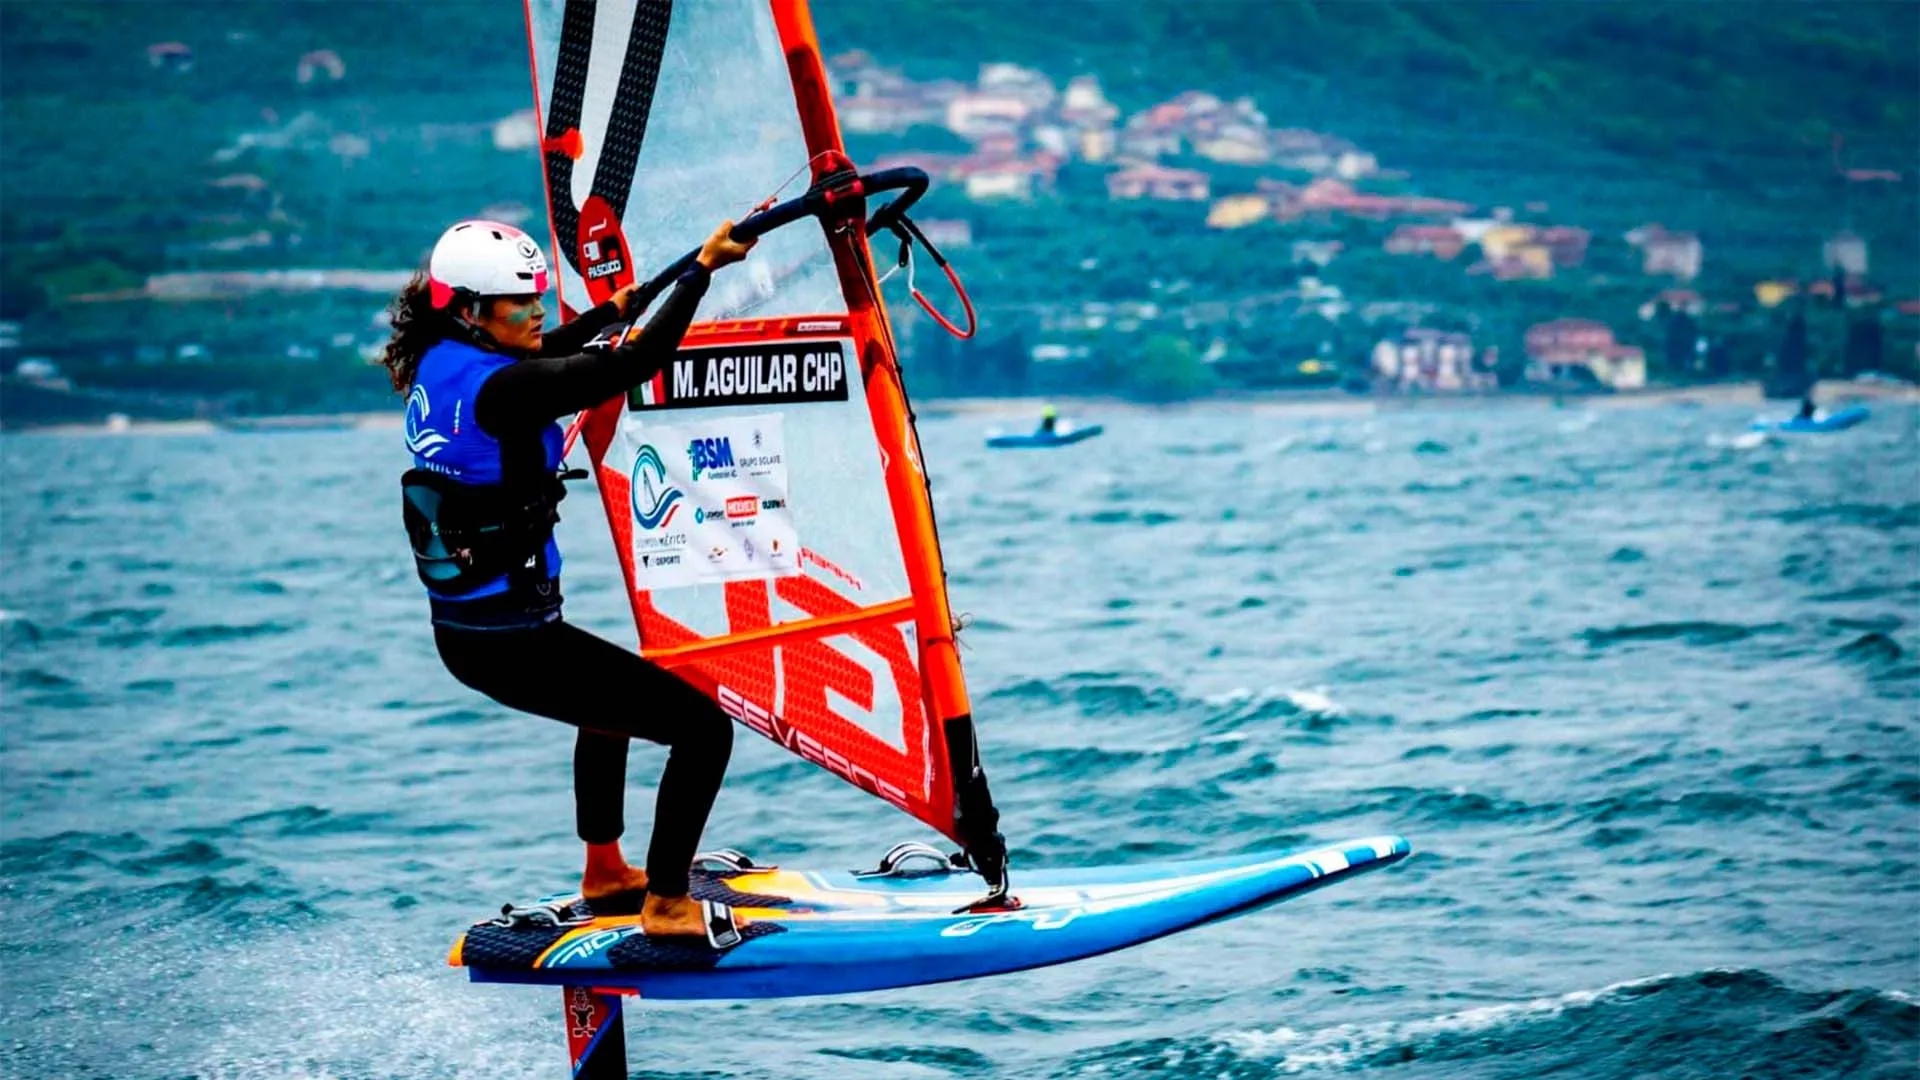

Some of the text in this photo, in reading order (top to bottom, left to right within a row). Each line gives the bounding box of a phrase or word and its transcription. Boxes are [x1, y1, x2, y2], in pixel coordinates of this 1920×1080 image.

[672, 352, 843, 399] M. AGUILAR CHP
[694, 436, 735, 470] BSM
[717, 683, 910, 807] SEVERNE
